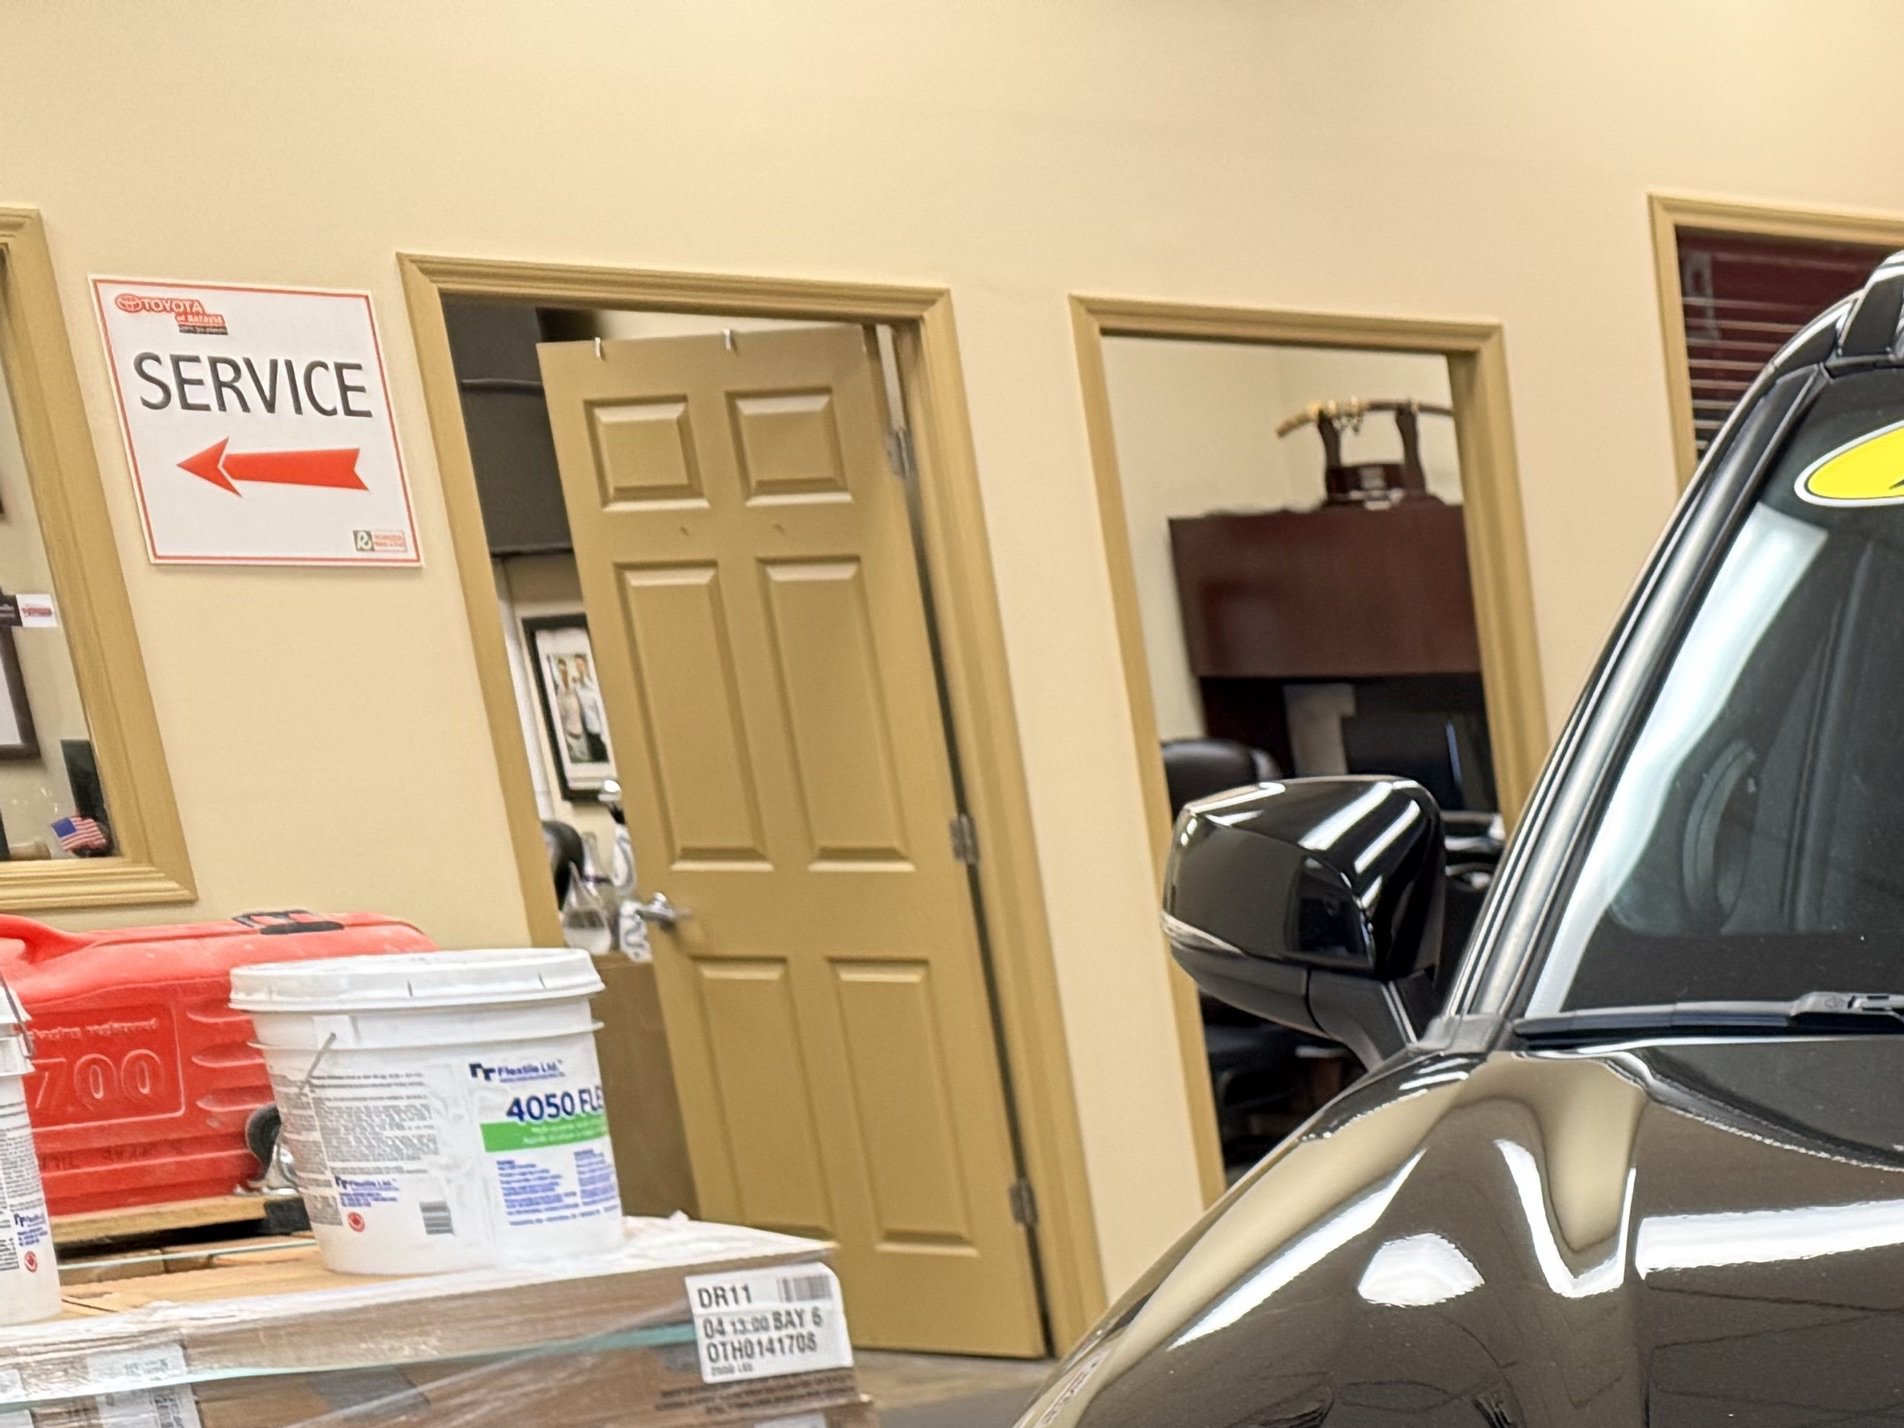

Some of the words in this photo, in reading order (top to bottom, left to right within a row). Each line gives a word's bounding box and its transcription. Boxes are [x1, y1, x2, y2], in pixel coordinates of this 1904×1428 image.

[140, 299, 204, 313] TOYOTA
[133, 352, 373, 418] SERVICE
[506, 1090, 576, 1123] 4050
[697, 1283, 752, 1309] DR11
